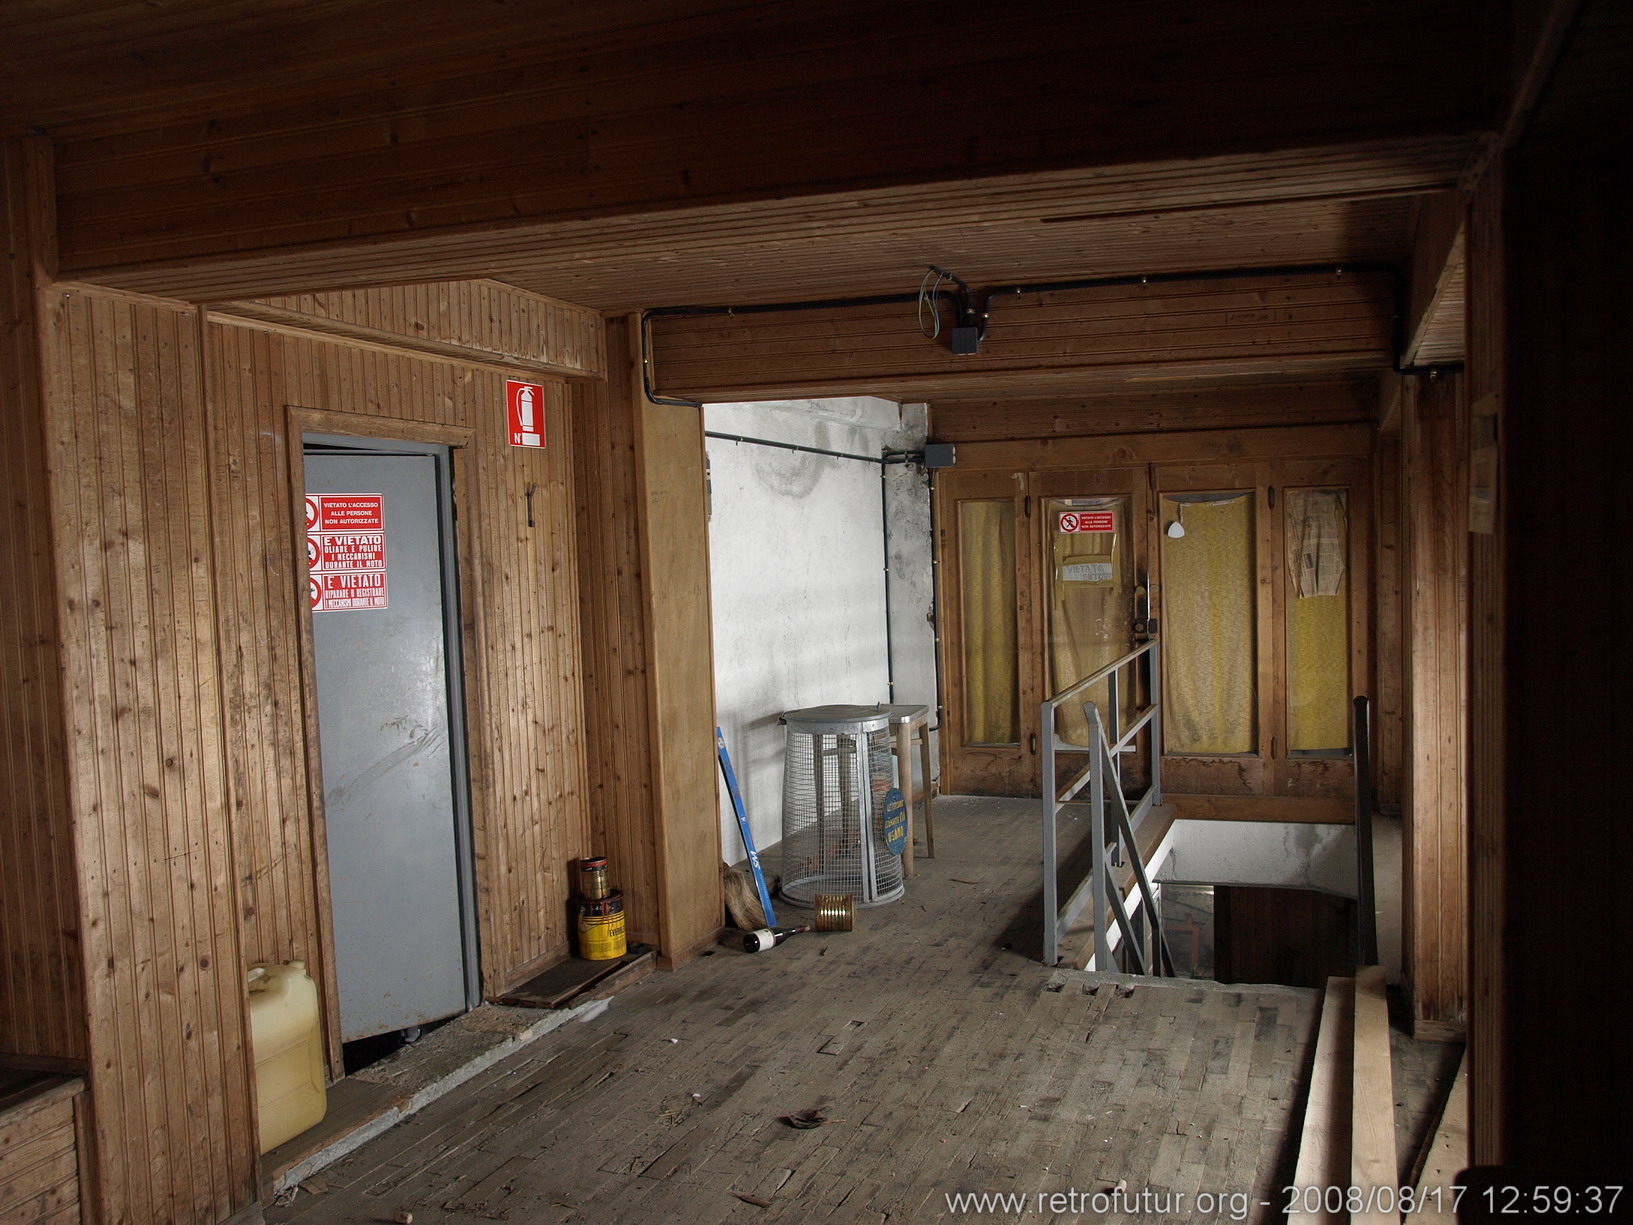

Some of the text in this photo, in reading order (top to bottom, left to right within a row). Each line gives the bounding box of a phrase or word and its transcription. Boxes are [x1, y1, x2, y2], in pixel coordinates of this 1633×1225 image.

[335, 536, 381, 545] VIETATO
[325, 545, 348, 553] OLIARE
[325, 561, 353, 569] DURANTE
[340, 574, 380, 588] VIETATO
[326, 589, 349, 599] RIPARARE
